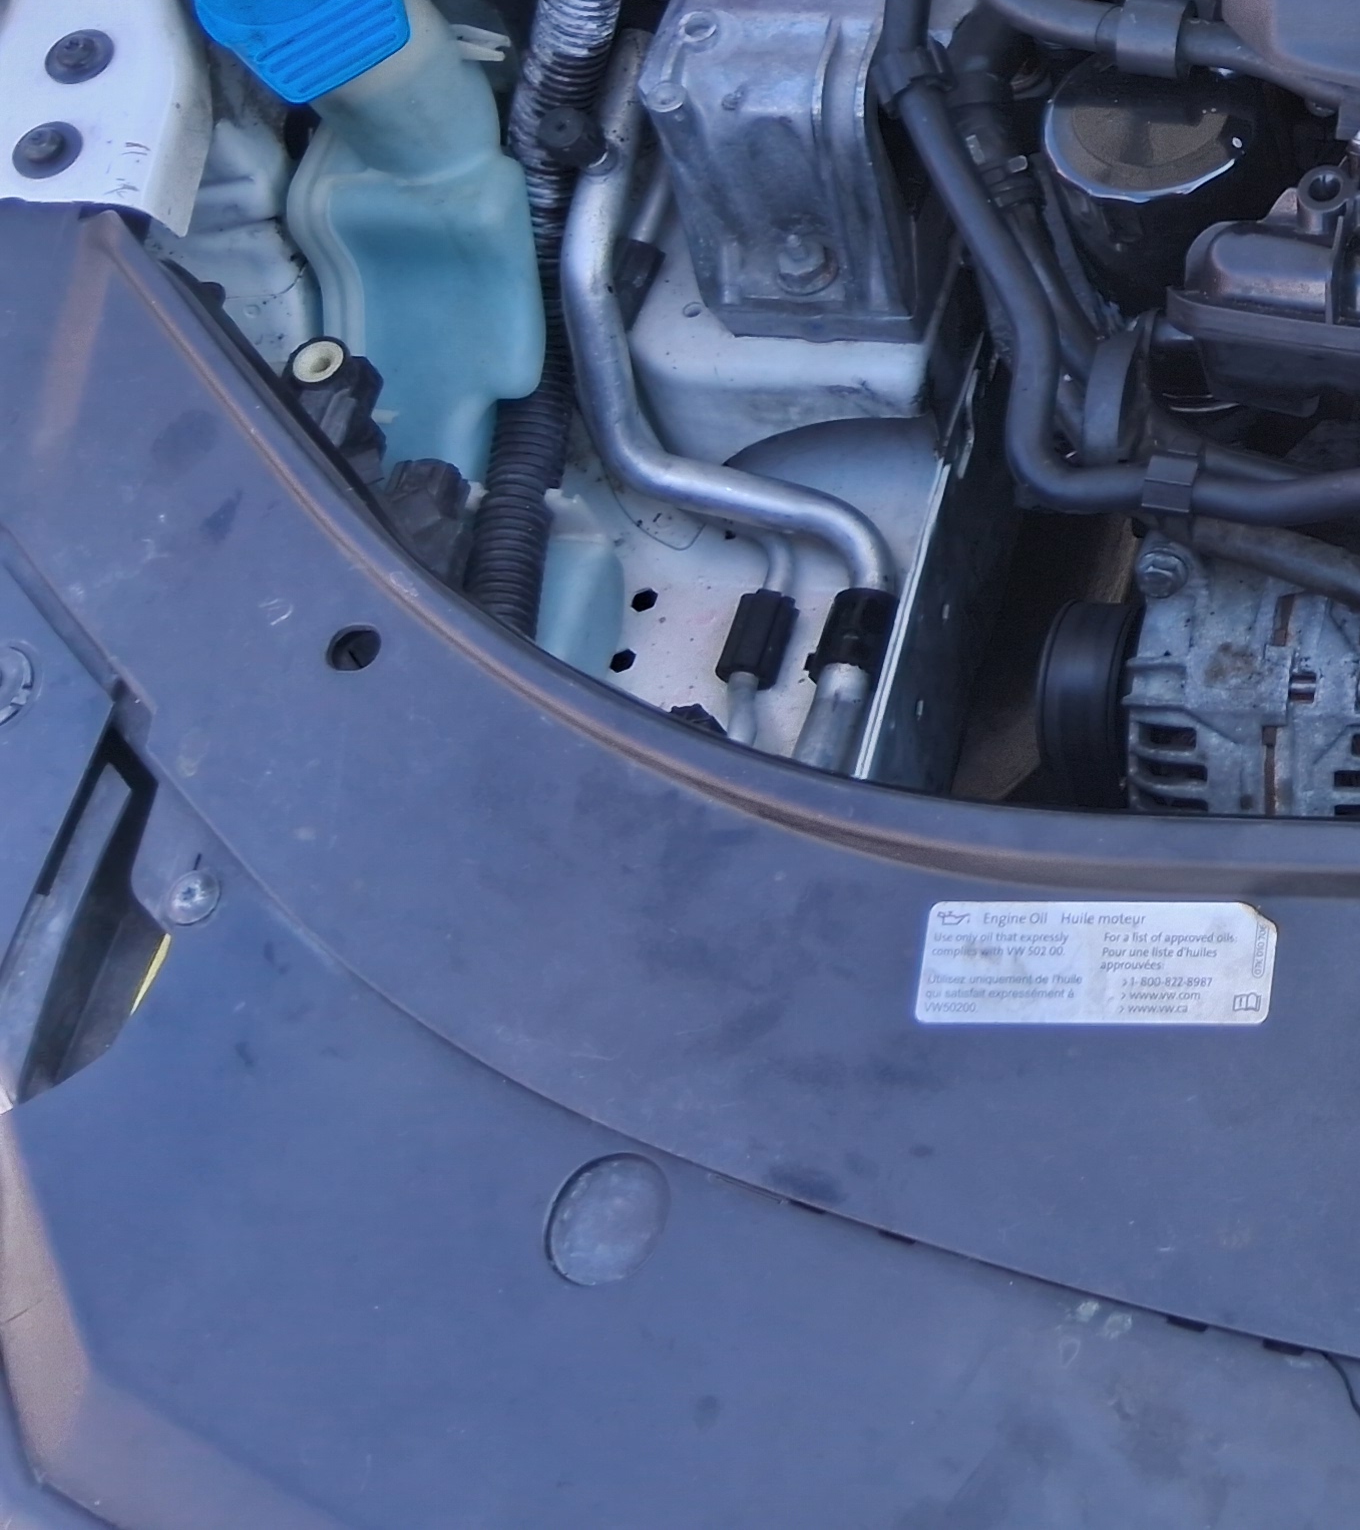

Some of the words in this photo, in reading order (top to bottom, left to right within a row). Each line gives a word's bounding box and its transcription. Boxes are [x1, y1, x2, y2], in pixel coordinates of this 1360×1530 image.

[983, 912, 1026, 927] Engine
[1029, 912, 1048, 924] Oil
[1060, 913, 1095, 925] Huile
[1098, 914, 1146, 926] moteur
[934, 932, 952, 942] Use
[955, 933, 978, 946] only
[980, 932, 993, 943] oil
[996, 932, 1017, 942] that
[1020, 933, 1069, 946] expressly
[1104, 933, 1121, 943] For
[1132, 932, 1148, 943] list
[1150, 932, 1163, 943] of
[1164, 933, 1213, 946] approved
[1007, 947, 1026, 957] VW
[1028, 946, 1046, 957] 502
[1102, 946, 1127, 957] Pour
[1130, 949, 1149, 957] une
[1152, 947, 1173, 958] liste
[1176, 947, 1218, 958] d'huiles
[1130, 977, 1213, 988] 1-800-822-8987
[1130, 991, 1201, 1001] www.vw.com
[1127, 1005, 1188, 1014] www.vw.ca
